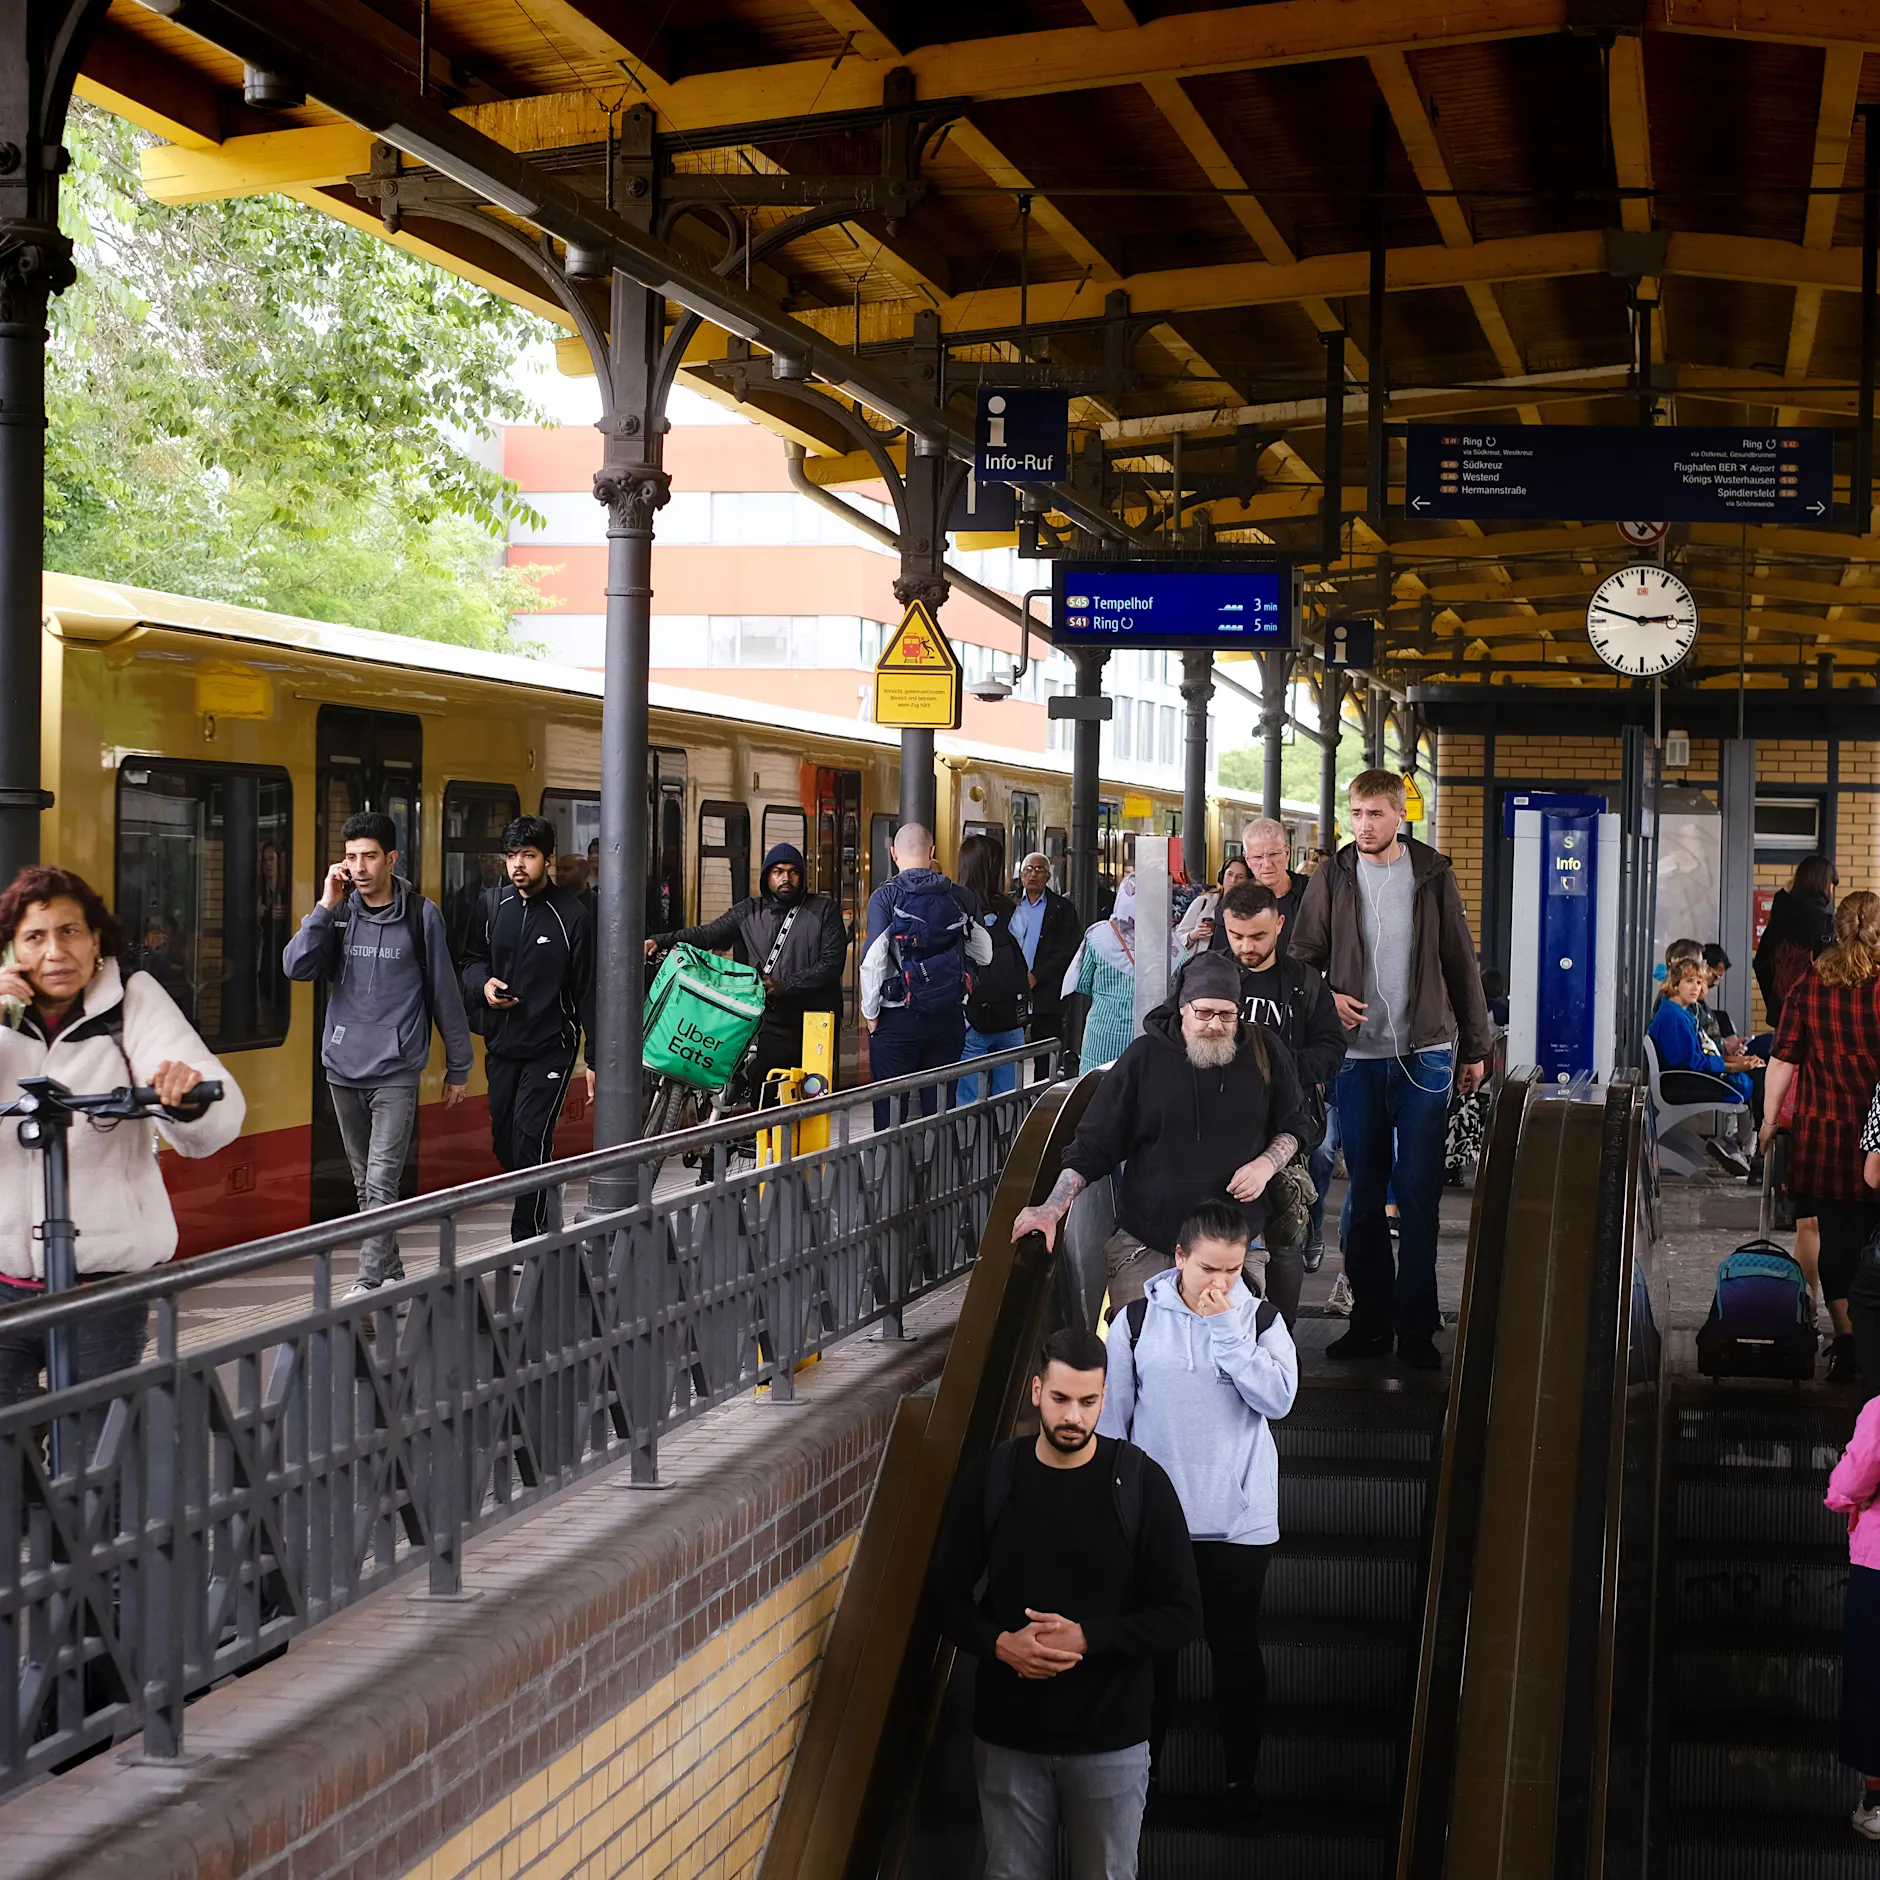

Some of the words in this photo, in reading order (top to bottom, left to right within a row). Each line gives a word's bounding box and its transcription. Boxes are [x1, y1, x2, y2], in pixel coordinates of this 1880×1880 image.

[1463, 437, 1483, 447] Ring
[1742, 439, 1763, 450] Ring
[985, 453, 1053, 471] Info-Ruf
[1462, 460, 1503, 469] Südkreuz
[1673, 462, 1716, 473] Flughafen
[1718, 463, 1737, 472] BER
[1749, 465, 1775, 473] Airport
[1462, 472, 1499, 481] Westend
[1682, 474, 1712, 486] Königs
[1714, 475, 1776, 485] Wusterhausen
[1462, 485, 1527, 495] Hermannstraße
[1717, 488, 1775, 499] Spindlersfeld
[1069, 597, 1087, 607] S45
[1093, 596, 1153, 612] Tempelhof
[1254, 598, 1261, 612] 3
[1264, 602, 1278, 611] min
[1069, 617, 1087, 627] S41
[1093, 616, 1118, 632] Ring
[1254, 618, 1261, 632] 5
[1264, 622, 1278, 632] min
[1564, 836, 1574, 849] S
[1556, 857, 1581, 870] Info
[677, 1017, 724, 1051] Uber
[667, 1035, 714, 1069] Eats
